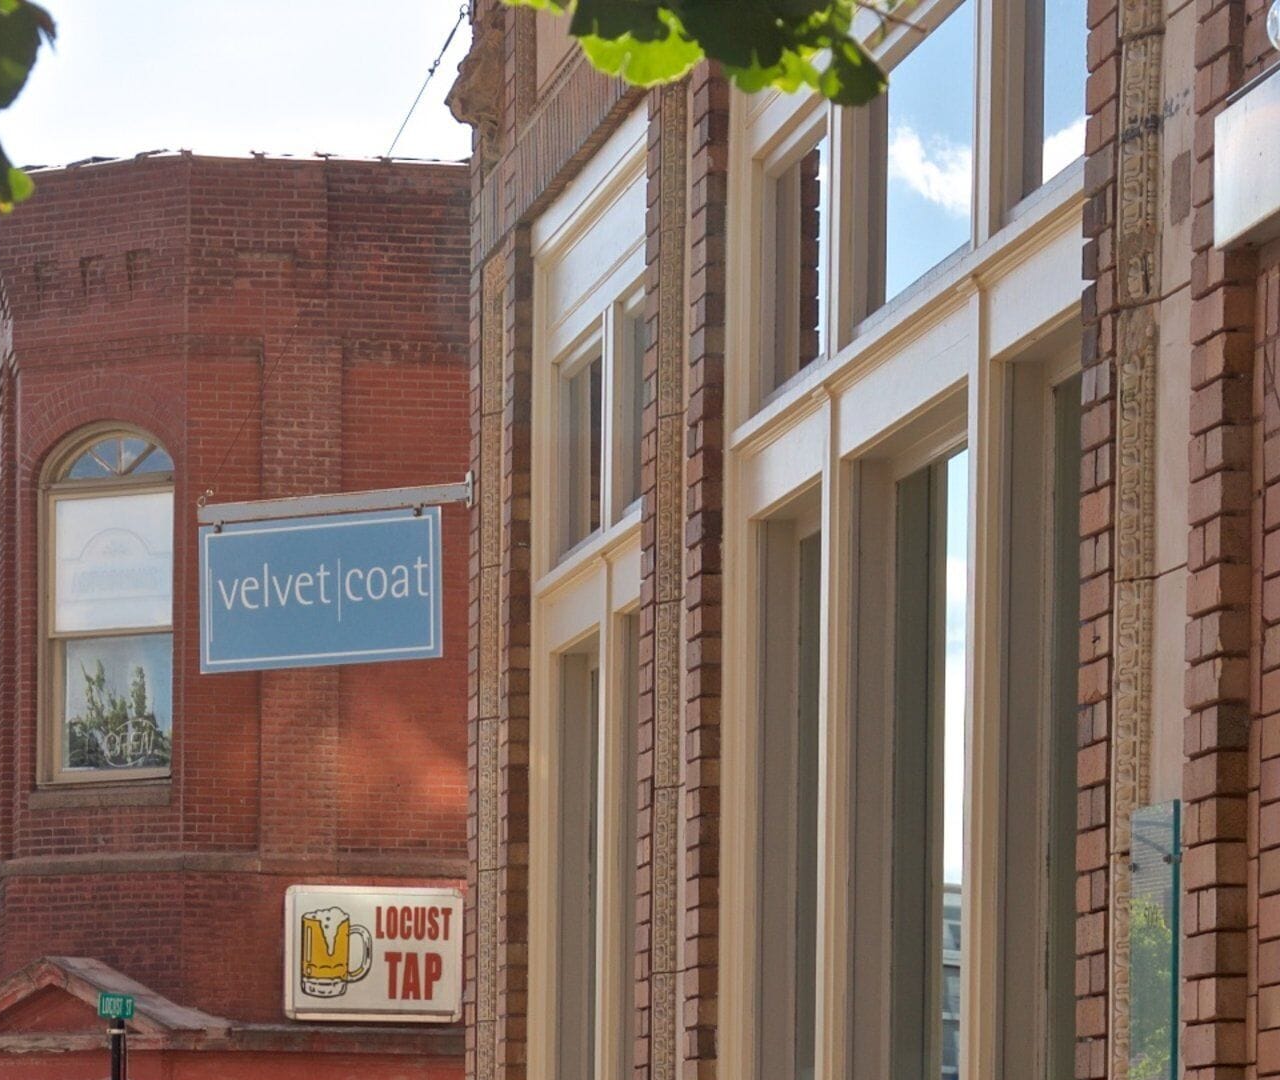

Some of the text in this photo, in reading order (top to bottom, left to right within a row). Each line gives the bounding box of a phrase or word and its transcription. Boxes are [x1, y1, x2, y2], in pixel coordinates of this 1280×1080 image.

[218, 562, 331, 610] velvet
[345, 555, 429, 602] coat
[375, 906, 453, 941] LOCUST
[384, 951, 443, 1001] TAP
